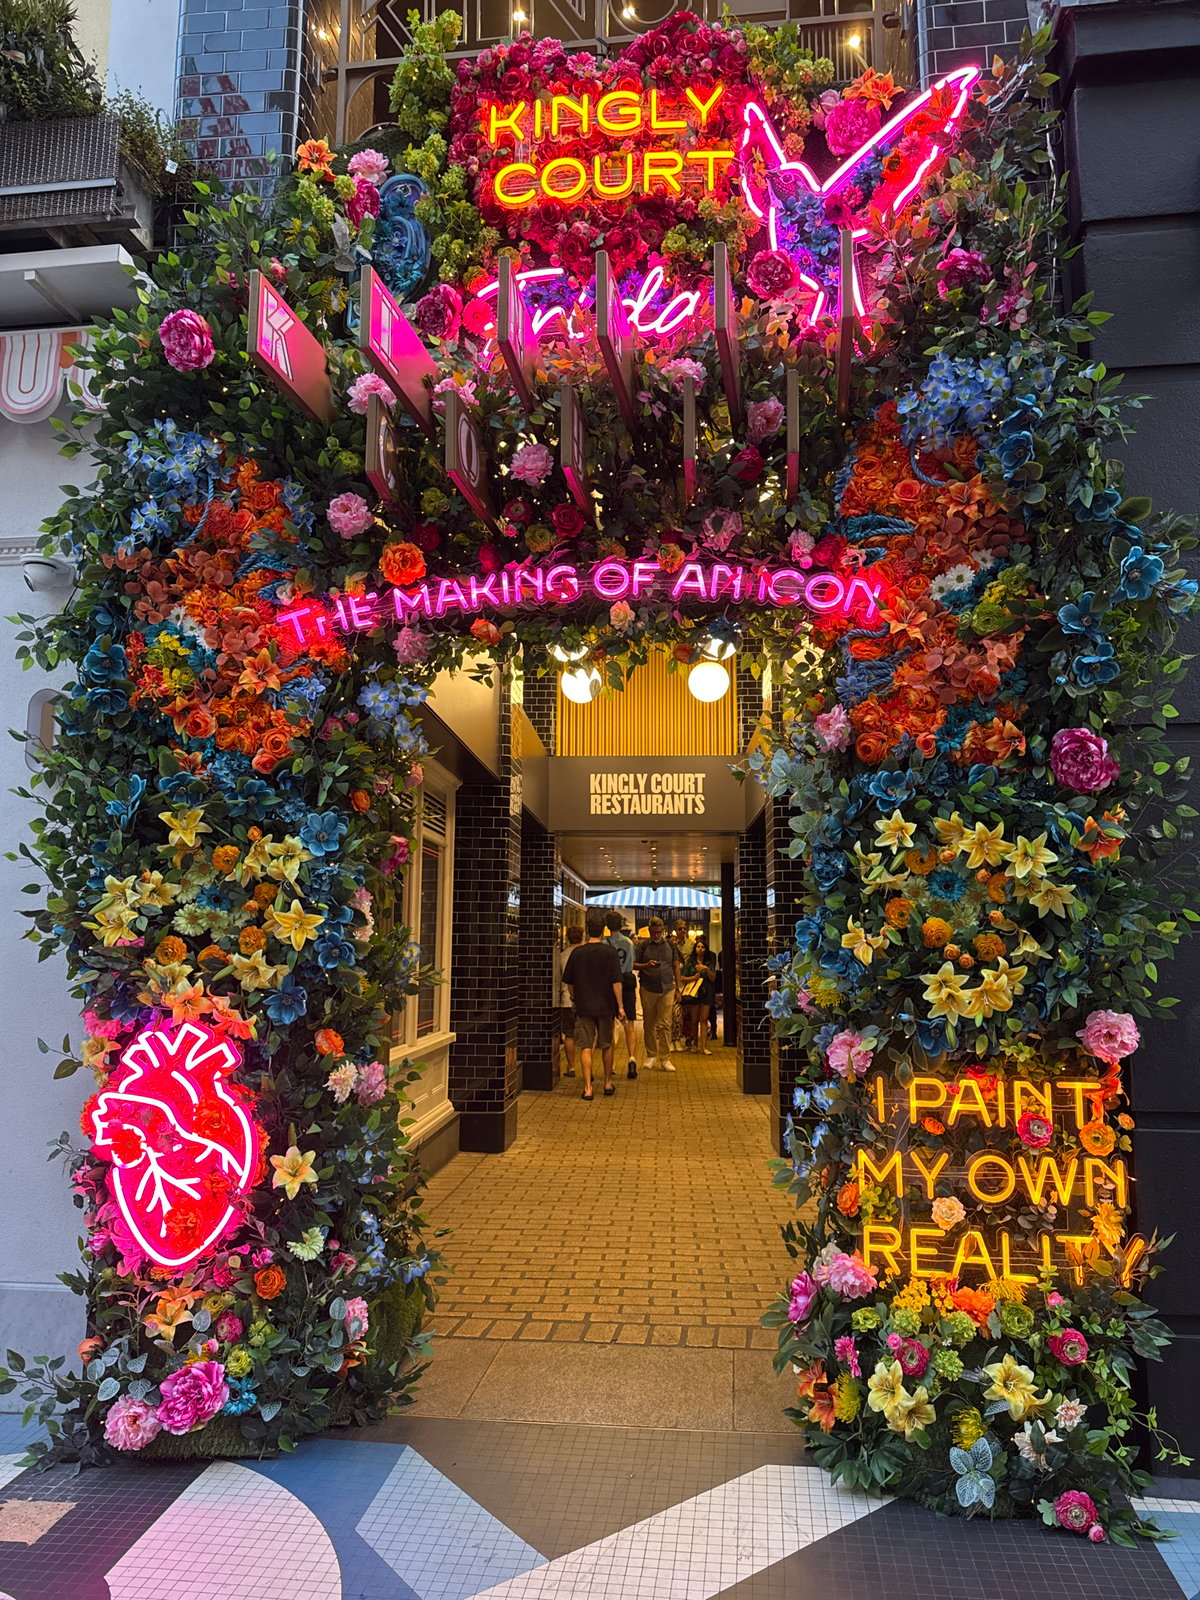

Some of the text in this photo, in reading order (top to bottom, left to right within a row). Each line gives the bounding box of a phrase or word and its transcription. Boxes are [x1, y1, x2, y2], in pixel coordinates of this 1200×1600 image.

[490, 86, 723, 144] KINGLY
[494, 150, 736, 204] COURT
[393, 566, 578, 620] MAKING
[594, 562, 661, 597] OF
[671, 563, 743, 598] AN
[758, 568, 881, 618] ICON
[590, 773, 706, 794] KINGLY COURT
[590, 794, 706, 815] RESTAURANTS
[876, 1076, 1102, 1130] I PAINT
[856, 1149, 1127, 1208] MY OWN
[863, 1225, 1146, 1288] REALITY
